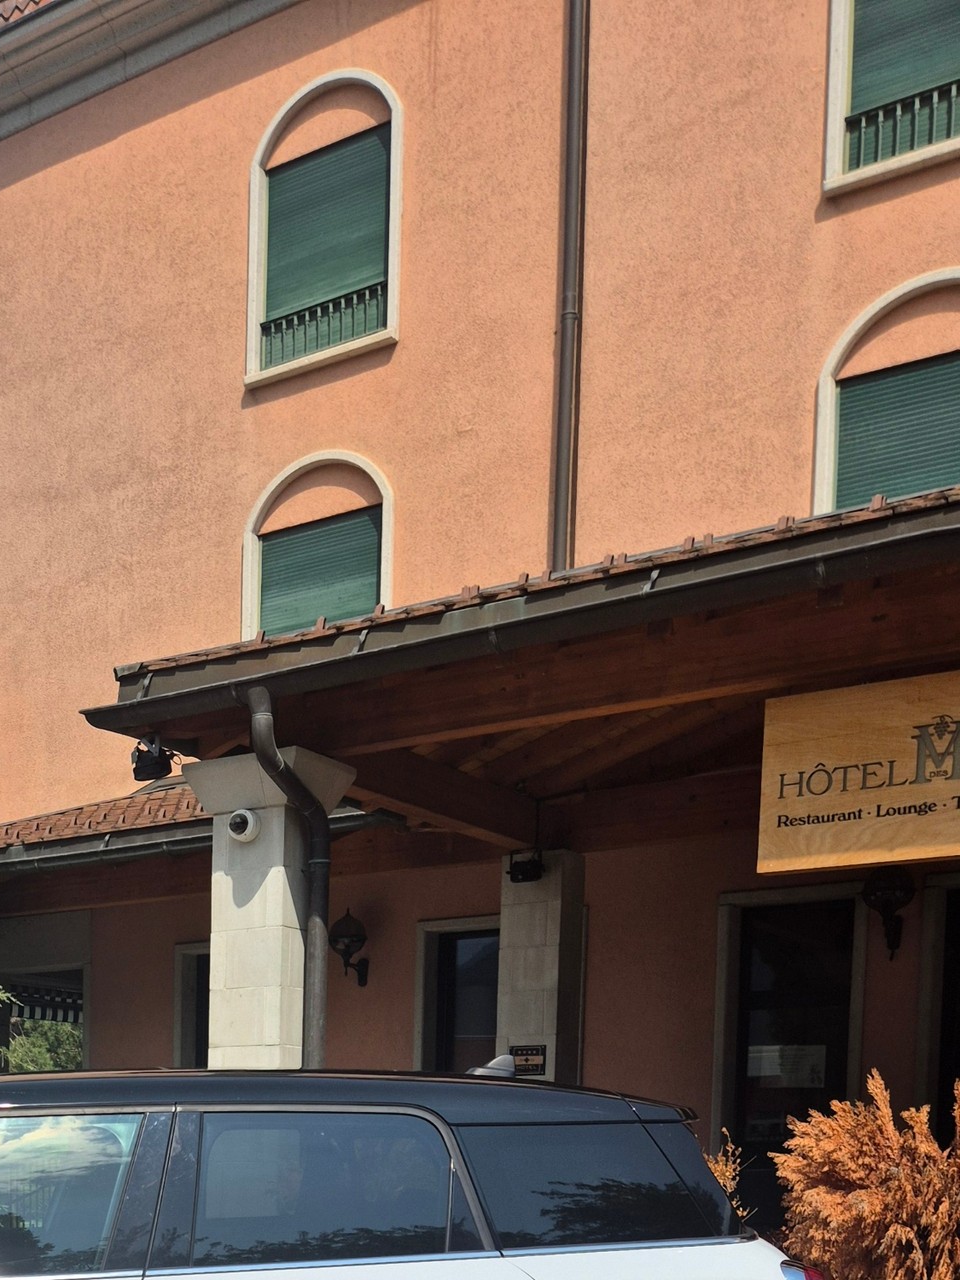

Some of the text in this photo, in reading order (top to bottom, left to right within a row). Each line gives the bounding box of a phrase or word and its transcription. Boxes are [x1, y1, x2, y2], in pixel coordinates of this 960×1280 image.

[777, 760, 909, 800] HÔTEL
[929, 769, 949, 779] DES
[776, 808, 863, 828] Restaurant
[876, 800, 938, 819] Lounge
